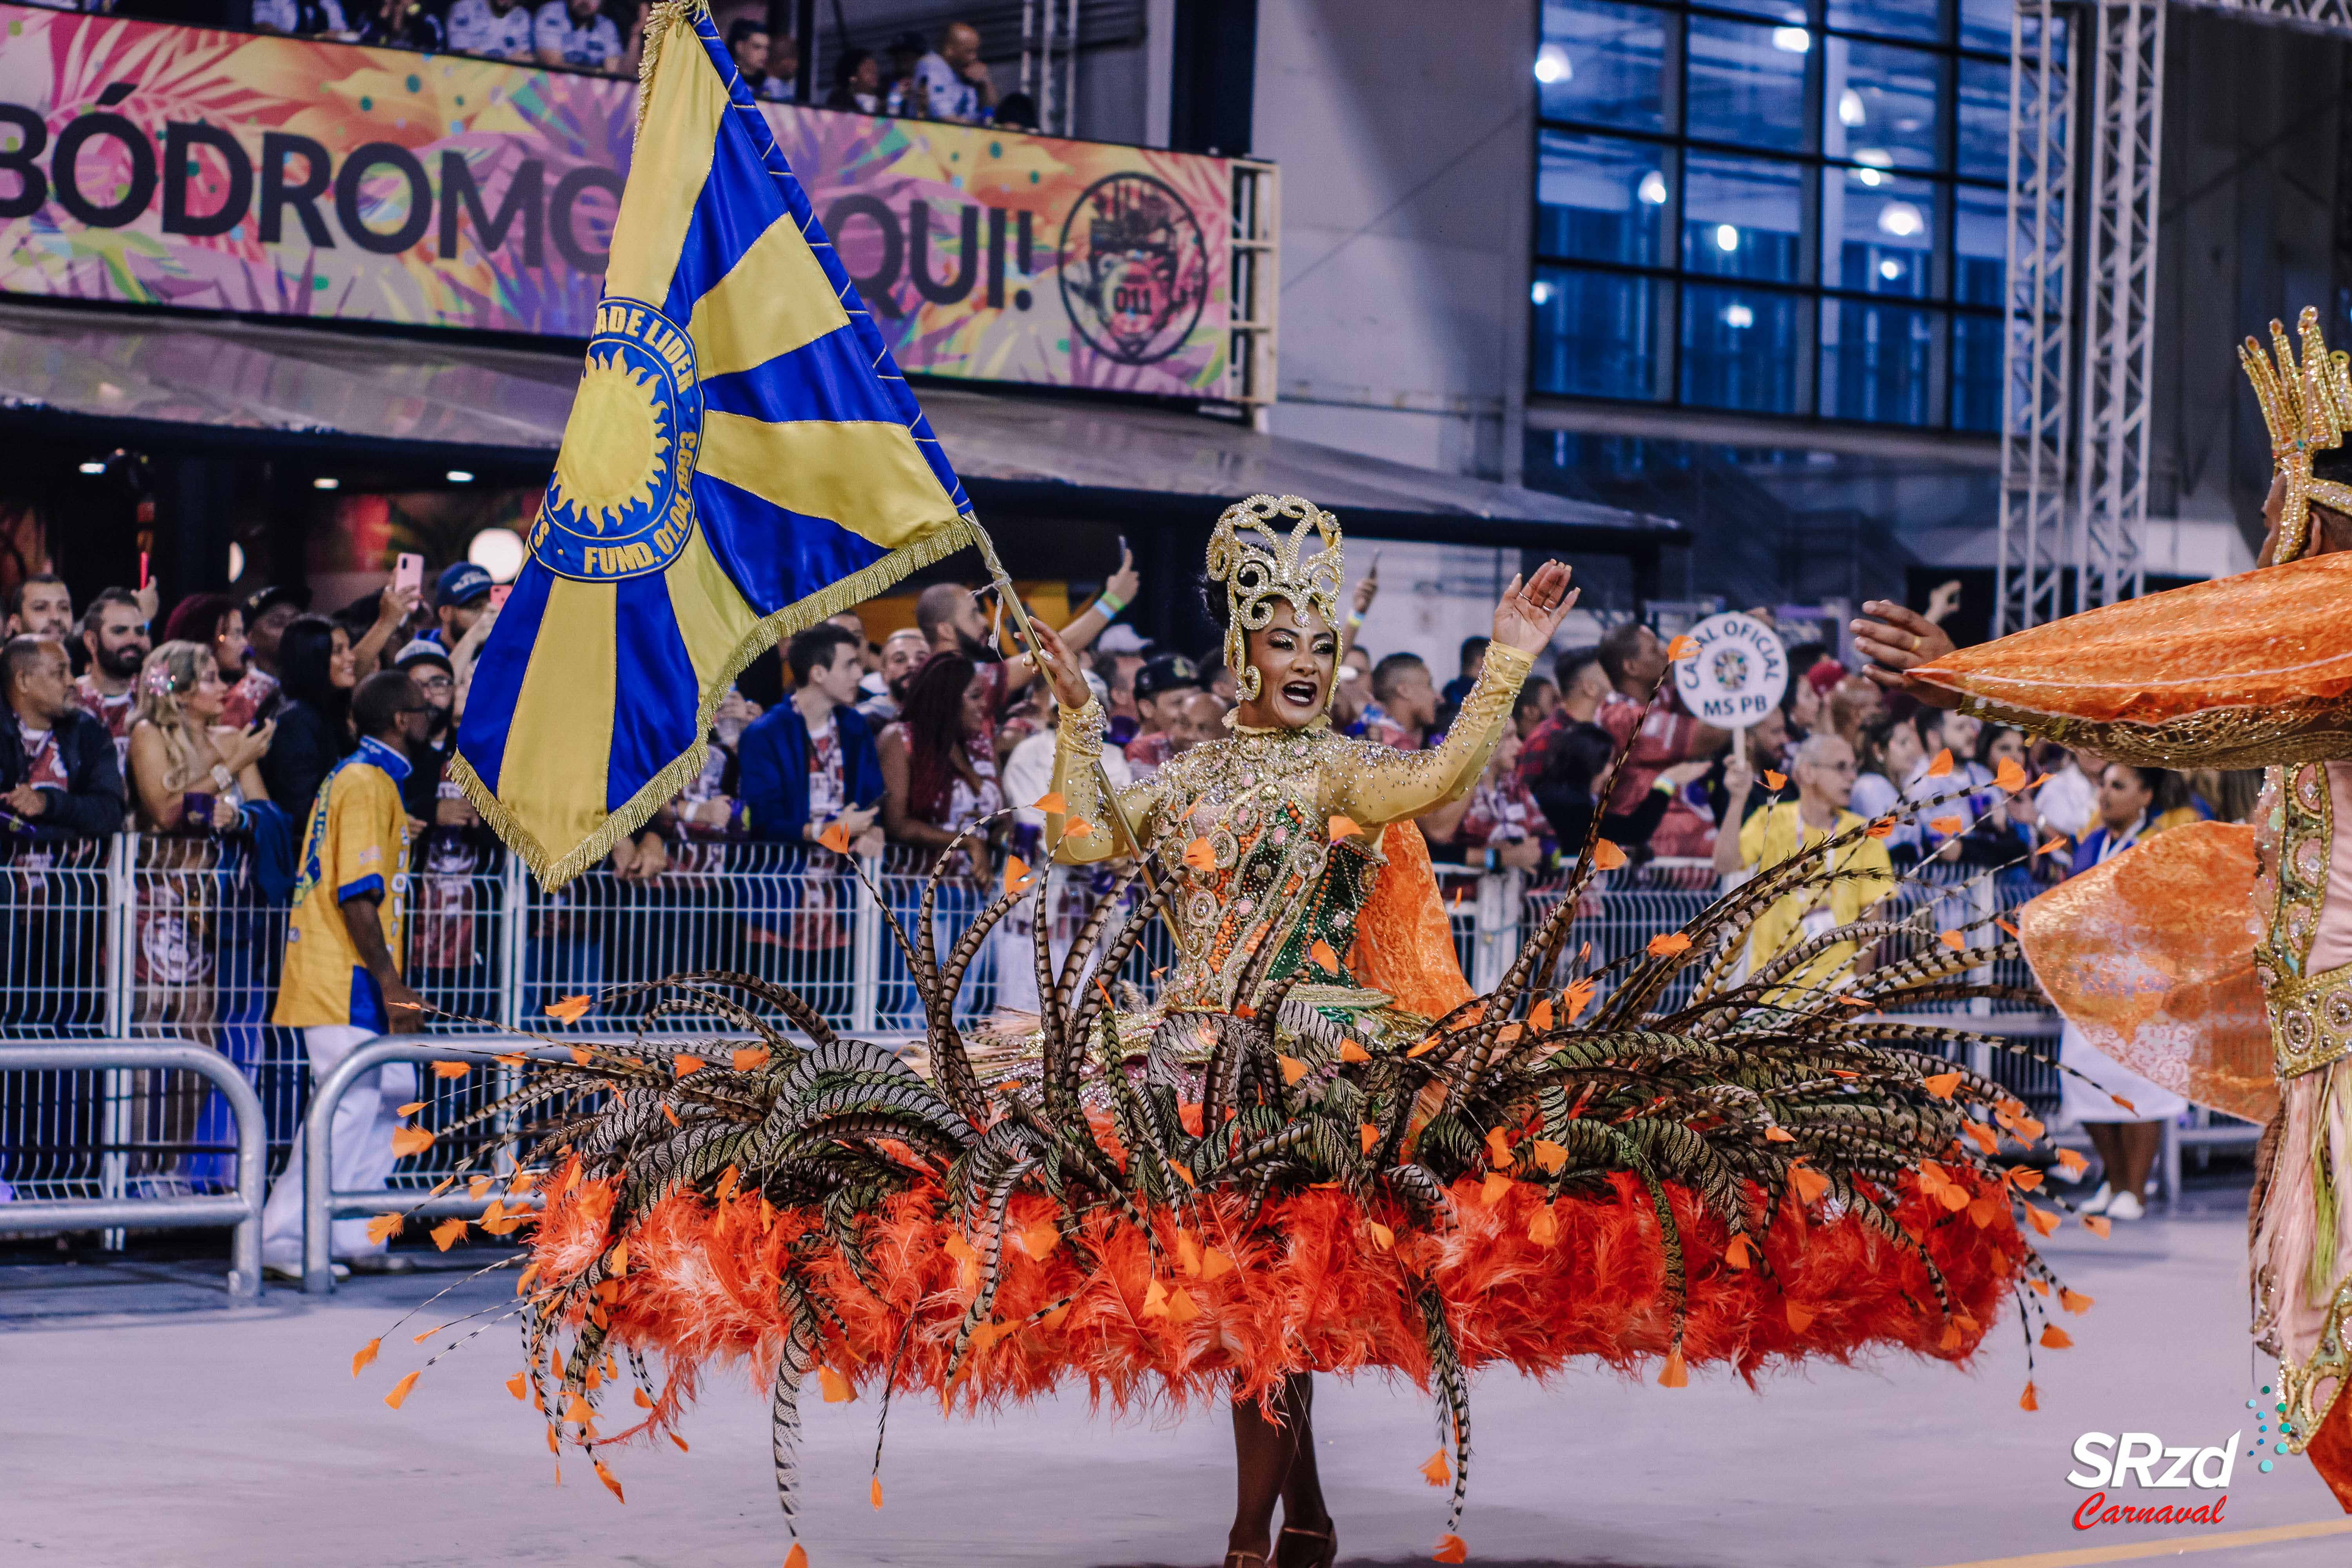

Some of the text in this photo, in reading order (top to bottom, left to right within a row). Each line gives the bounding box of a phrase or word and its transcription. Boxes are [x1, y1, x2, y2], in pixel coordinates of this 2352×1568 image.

[642, 319, 695, 394] LIDER
[584, 542, 662, 575] FUND.
[1683, 620, 1780, 690] CAAL OFICIAL
[1703, 695, 1767, 716] MS PB
